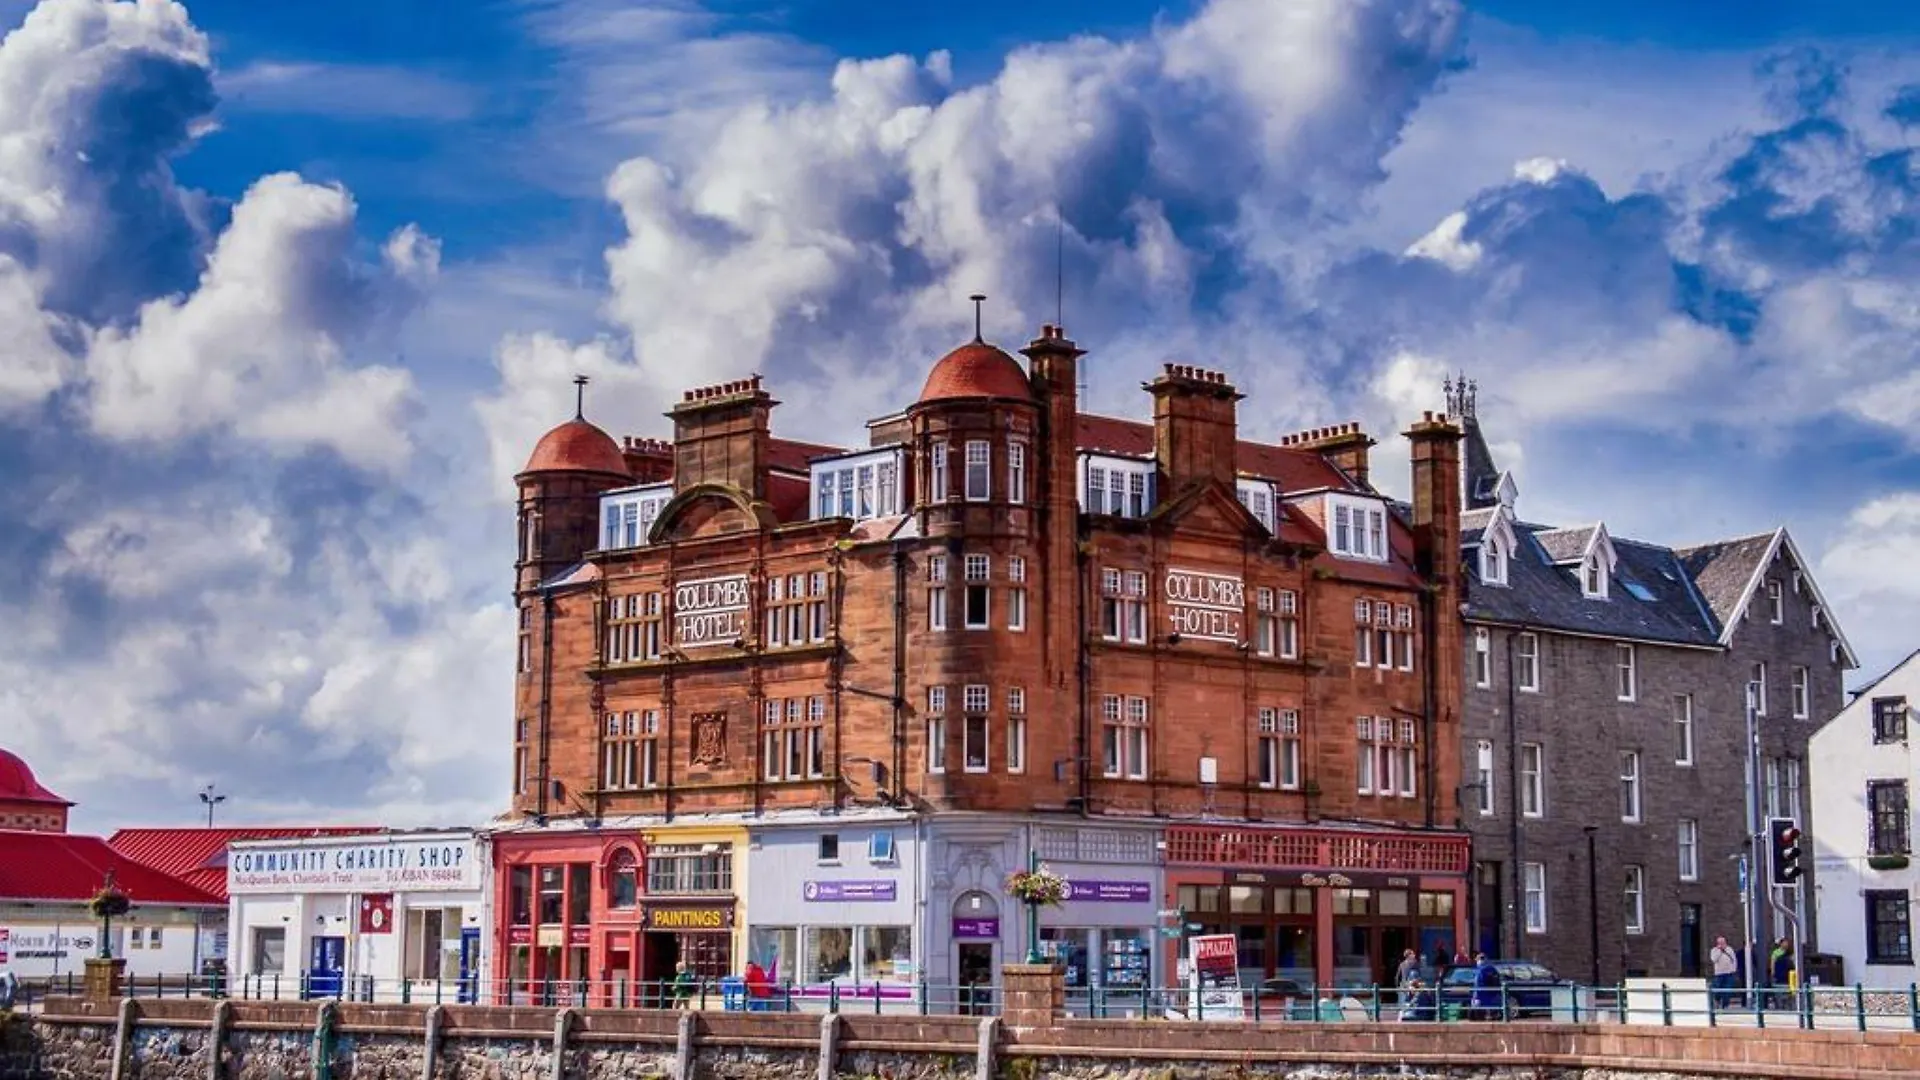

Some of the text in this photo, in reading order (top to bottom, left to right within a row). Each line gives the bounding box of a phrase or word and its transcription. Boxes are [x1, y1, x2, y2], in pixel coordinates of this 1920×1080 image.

[675, 578, 749, 611] COLUMBA
[1165, 574, 1245, 607] COLUMBA
[235, 846, 464, 872] COMMUNITY CHARITY SHOP
[655, 910, 720, 927] PAINTINGS
